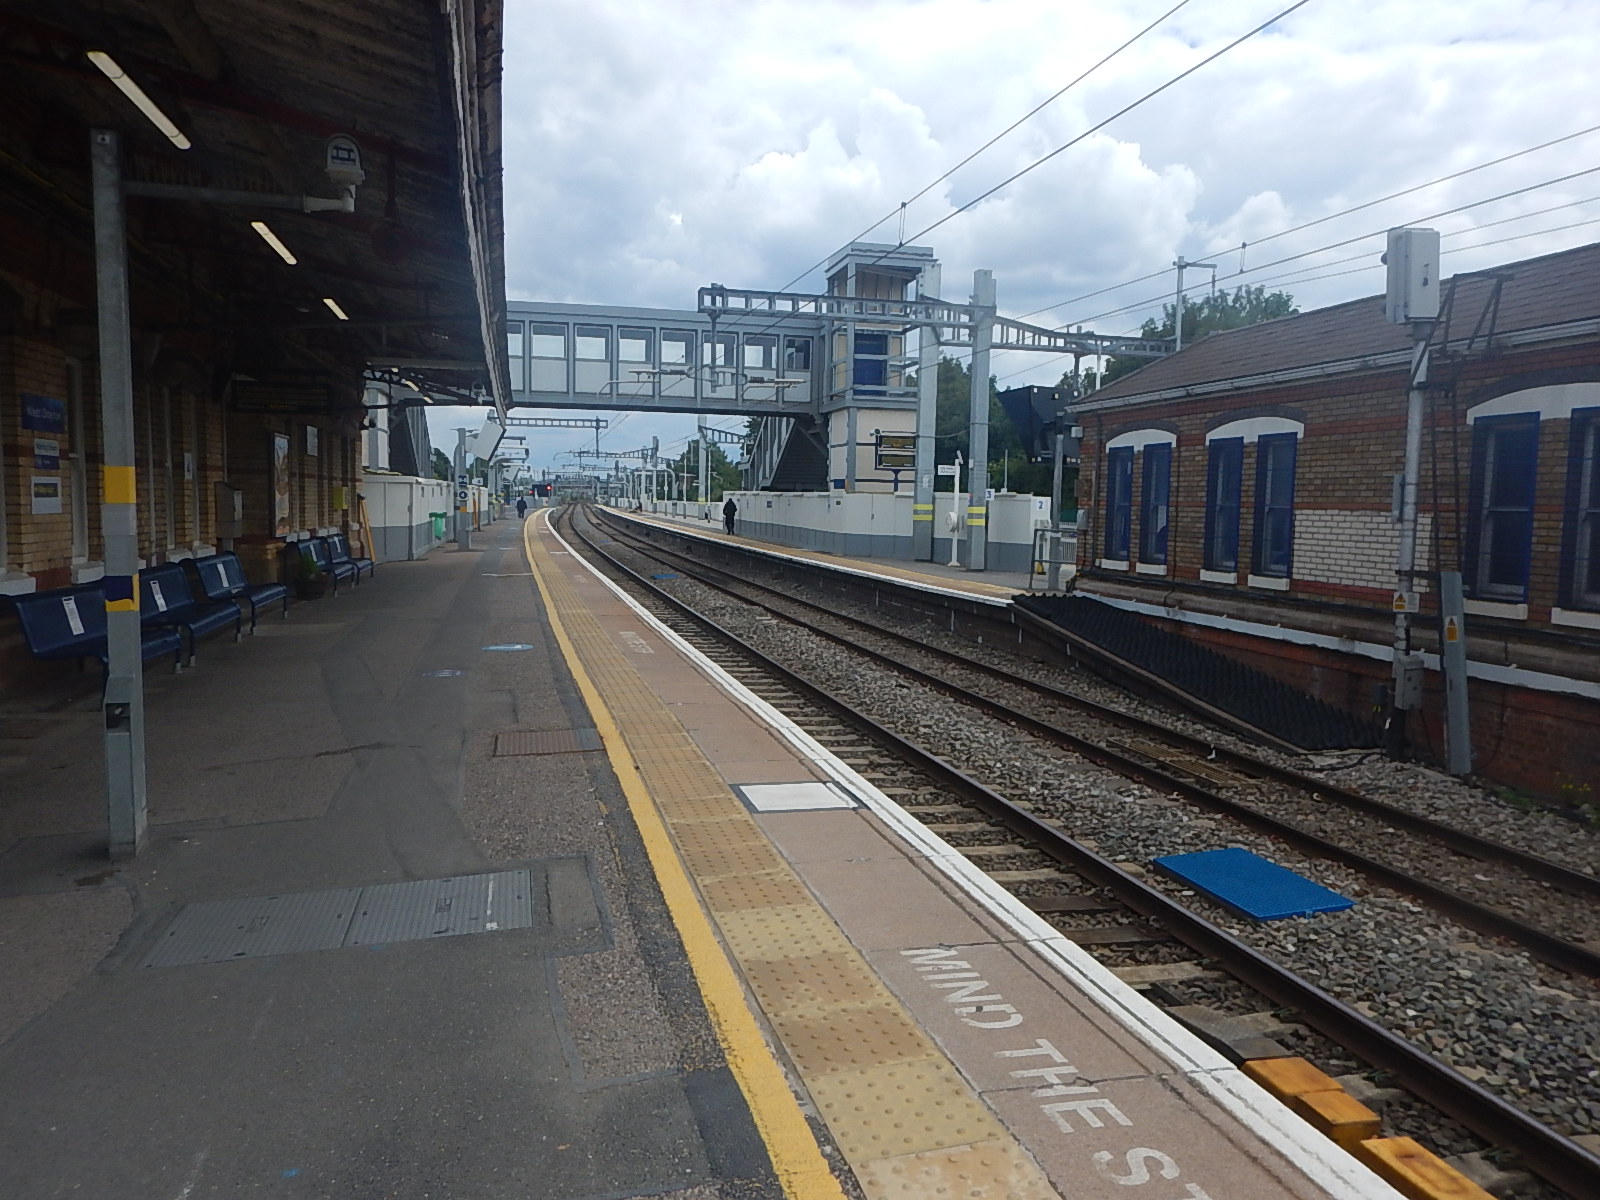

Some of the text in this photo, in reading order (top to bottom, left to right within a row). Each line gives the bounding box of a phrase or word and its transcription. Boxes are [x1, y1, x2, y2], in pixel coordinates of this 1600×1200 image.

[986, 490, 992, 499] 3
[1038, 500, 1044, 510] 2
[899, 947, 1024, 1030] MIND
[993, 1037, 1134, 1134] THE
